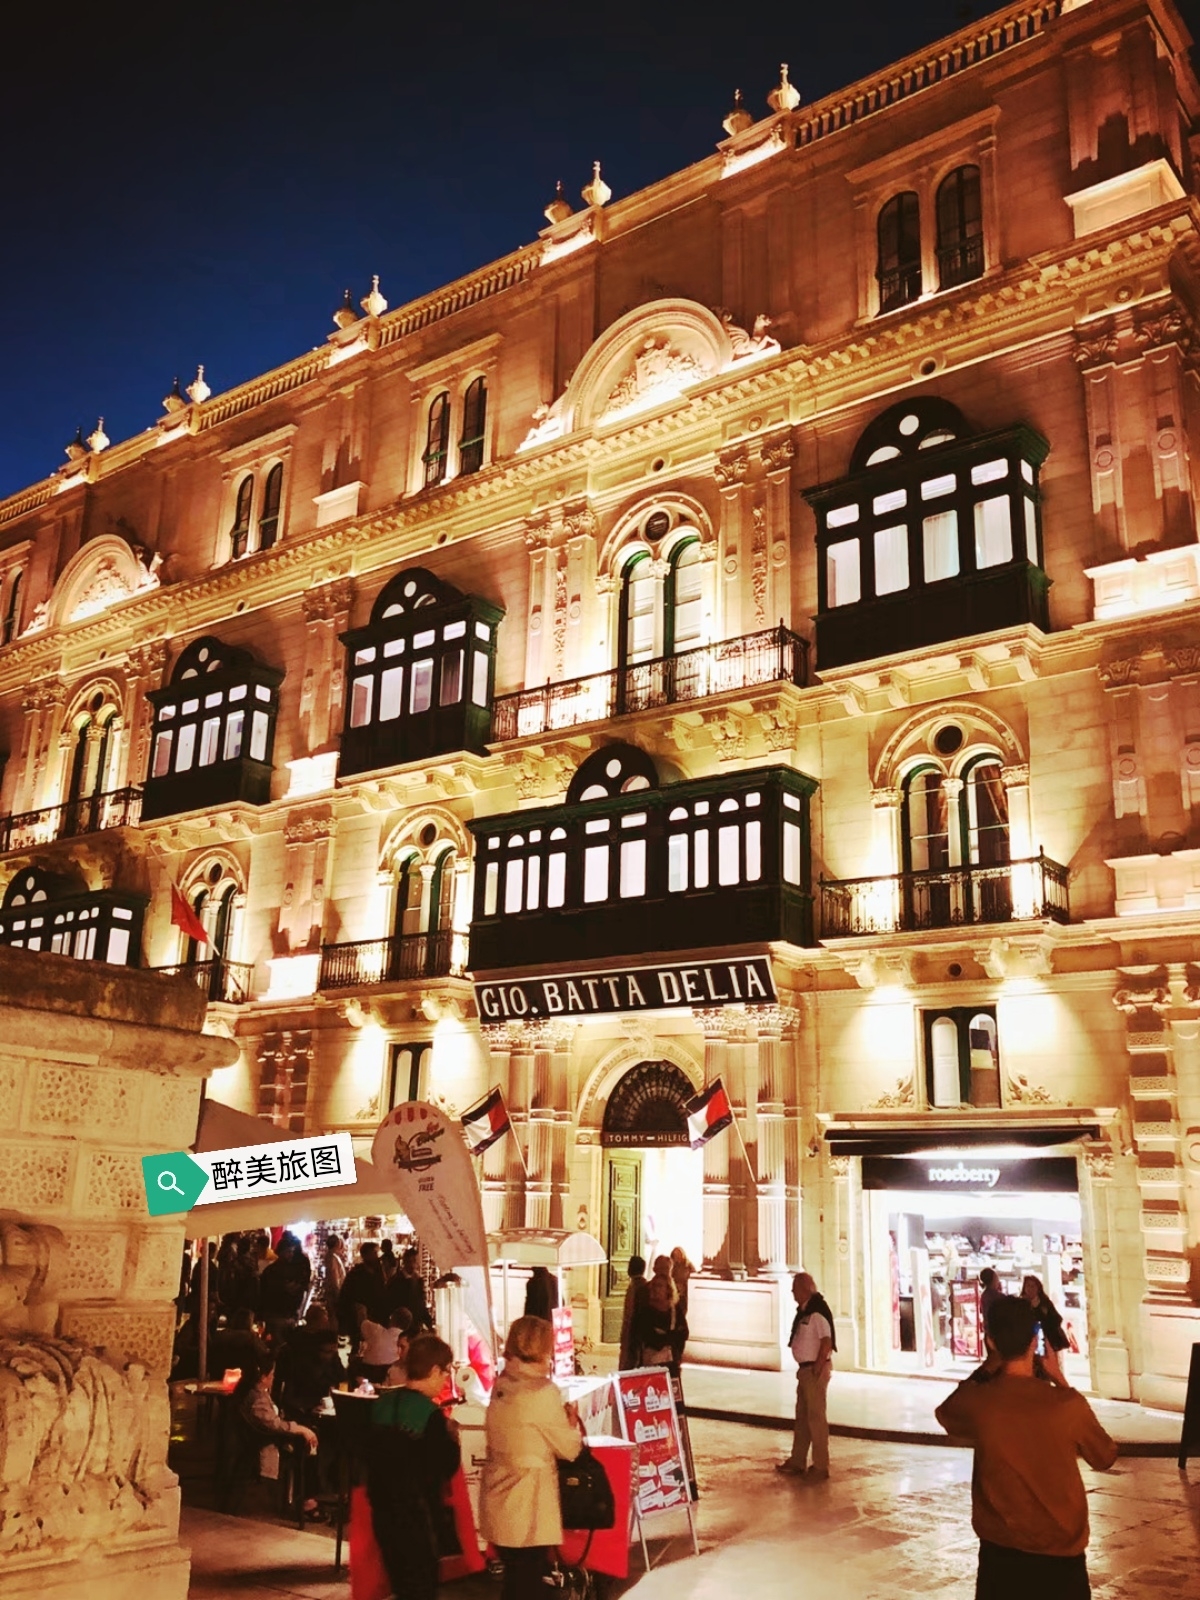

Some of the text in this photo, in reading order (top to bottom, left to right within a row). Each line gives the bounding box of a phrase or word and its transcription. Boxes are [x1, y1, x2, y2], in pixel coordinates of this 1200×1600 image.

[480, 963, 768, 1017] GIO. BATTA DELIA
[609, 1134, 688, 1143] TOMMY HILFIG
[927, 1161, 1001, 1188] roseberry
